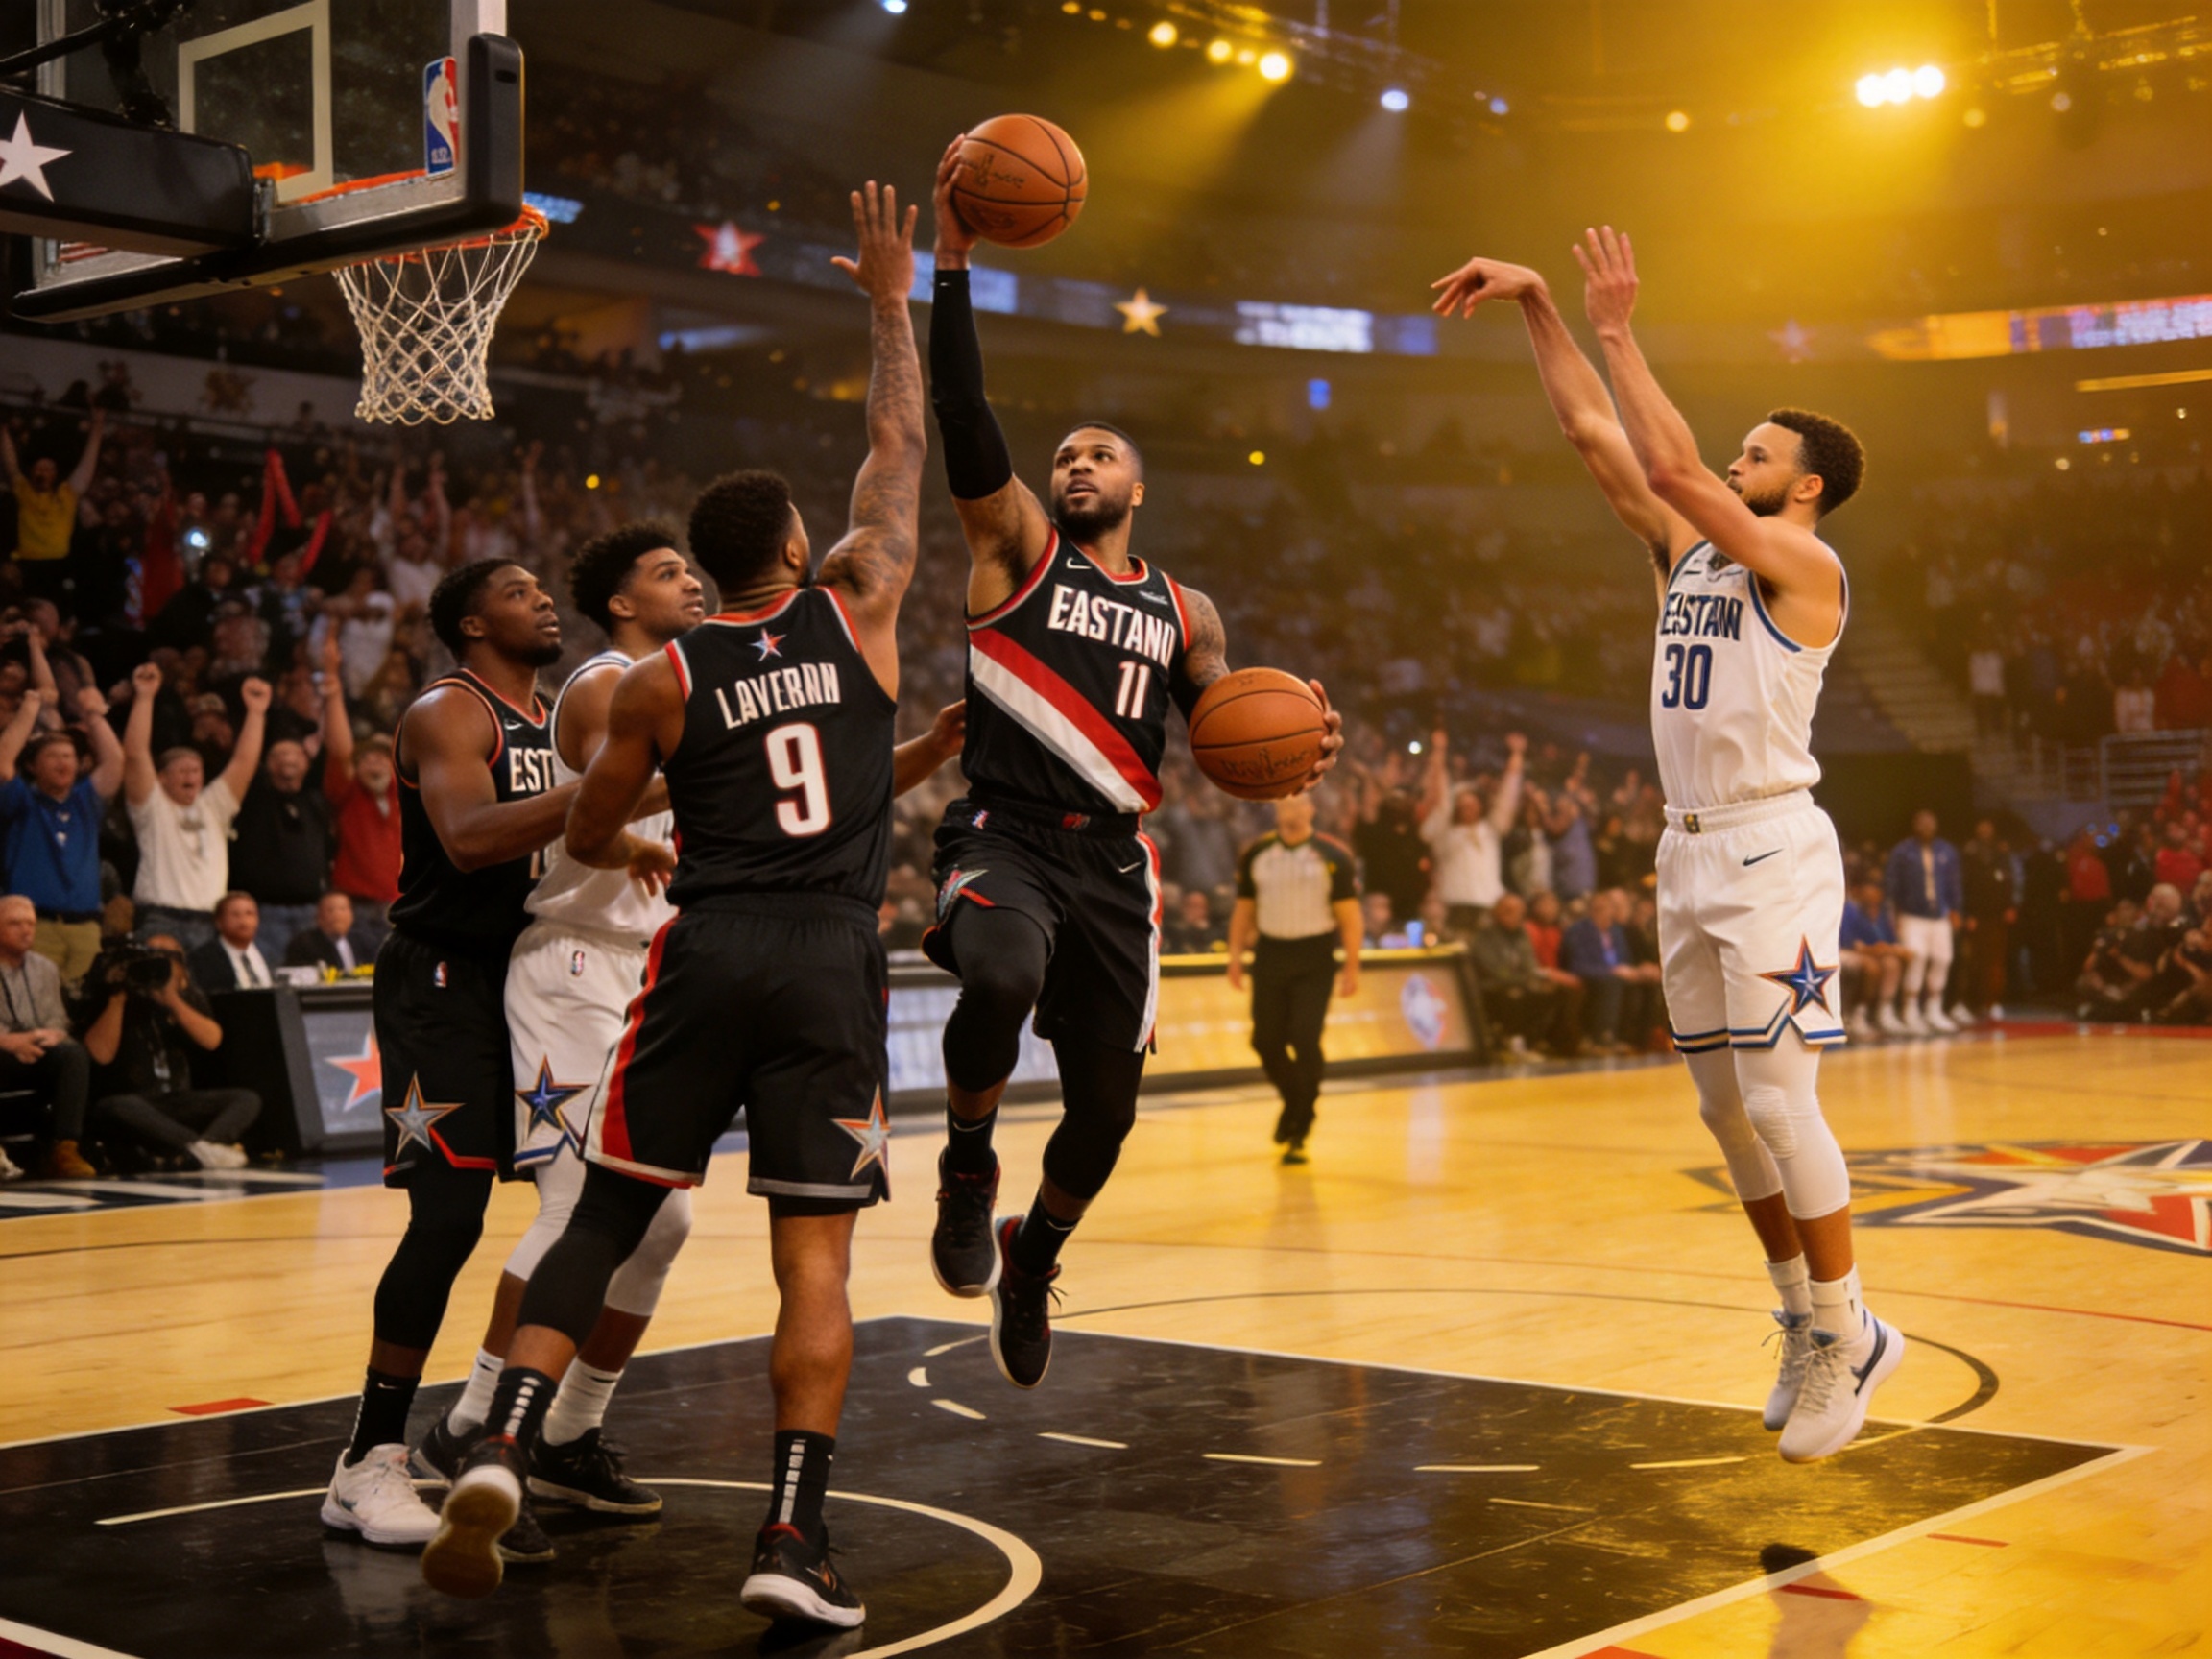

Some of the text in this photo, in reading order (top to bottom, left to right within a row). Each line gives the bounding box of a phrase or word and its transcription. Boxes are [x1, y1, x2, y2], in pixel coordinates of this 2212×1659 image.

[1116, 661, 1151, 720] 11
[1662, 643, 1713, 709] 30
[765, 722, 831, 838] 9
